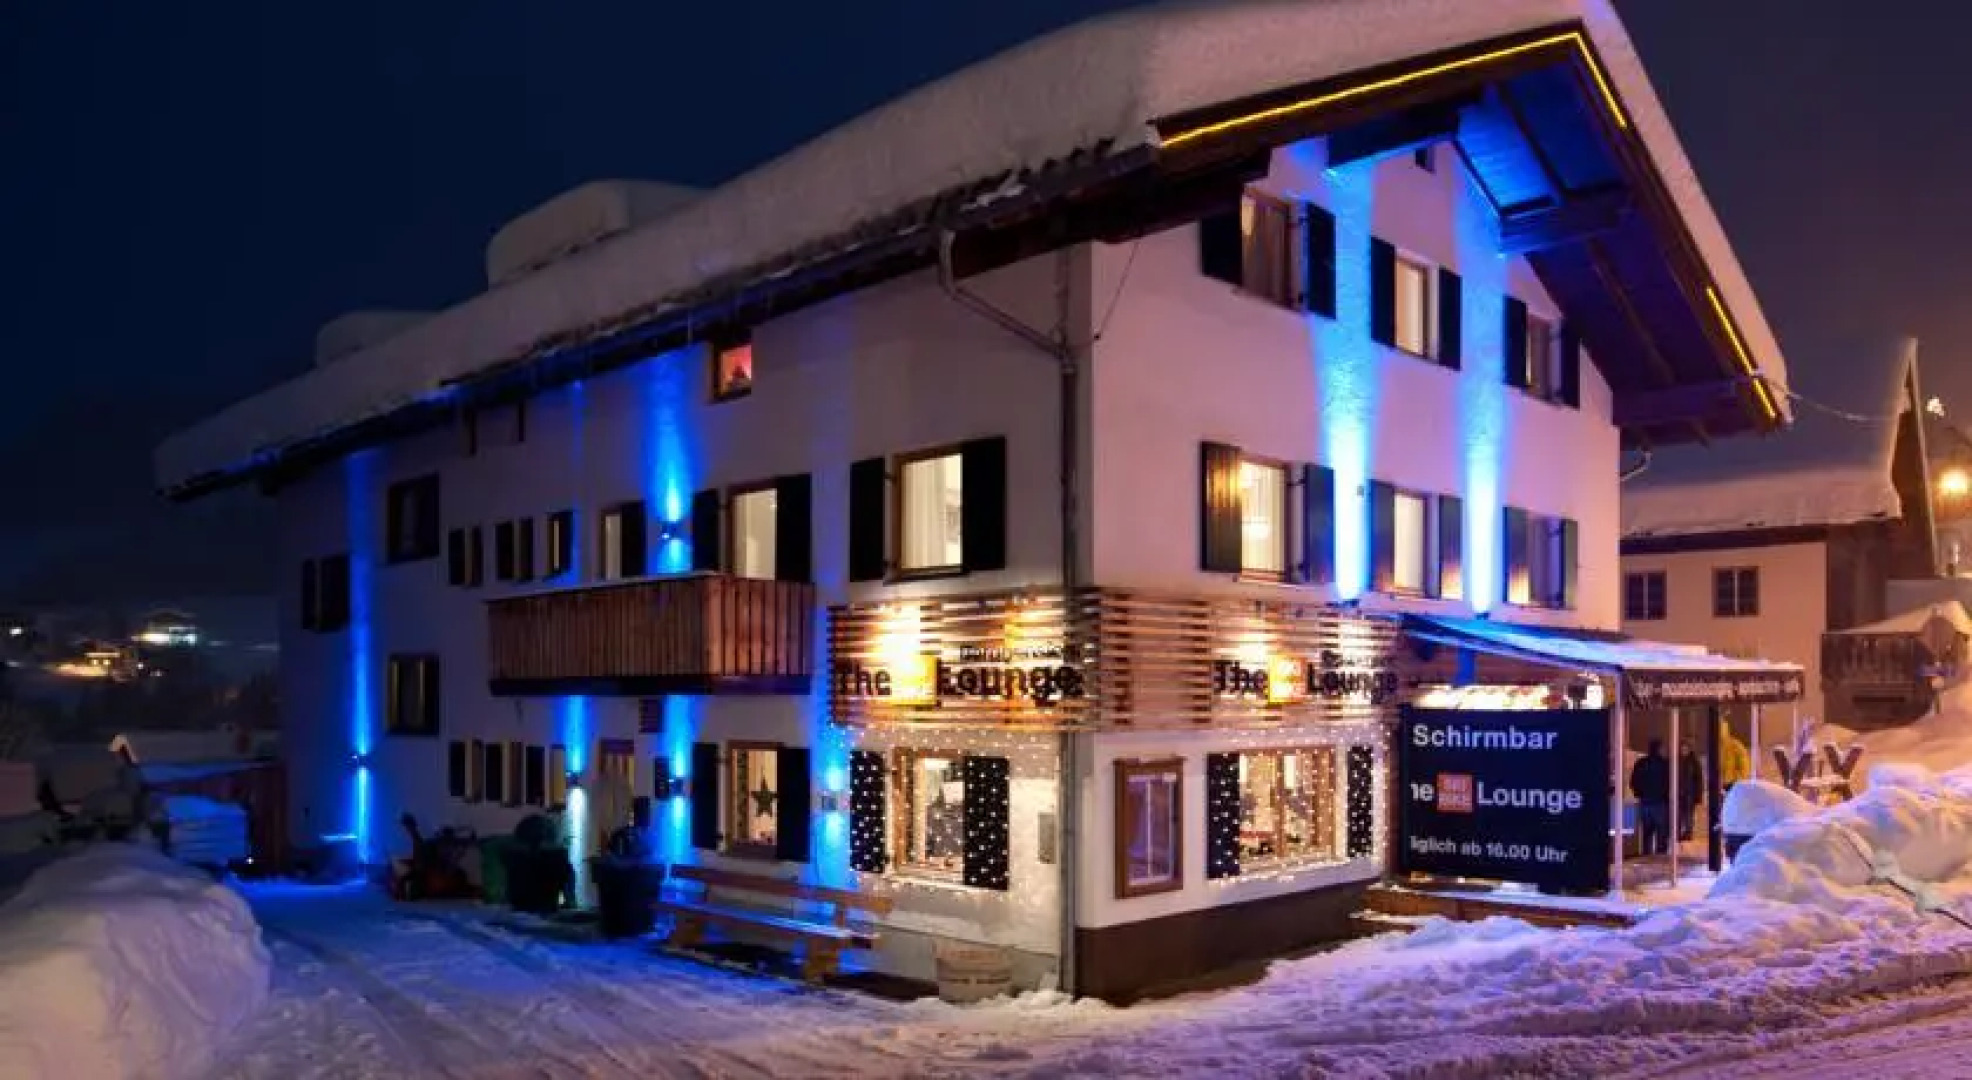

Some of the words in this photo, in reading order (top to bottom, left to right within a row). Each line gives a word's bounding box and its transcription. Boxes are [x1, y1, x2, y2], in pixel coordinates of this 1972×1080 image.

[937, 659, 1084, 707] Lounge
[1213, 660, 1269, 695] The
[1307, 661, 1398, 704] Lounge
[1412, 723, 1559, 750] Schirmbar
[1477, 781, 1584, 814] Lounge
[1461, 840, 1482, 856] ab
[1486, 842, 1531, 860] 16.00
[1535, 845, 1568, 862] Uhr
